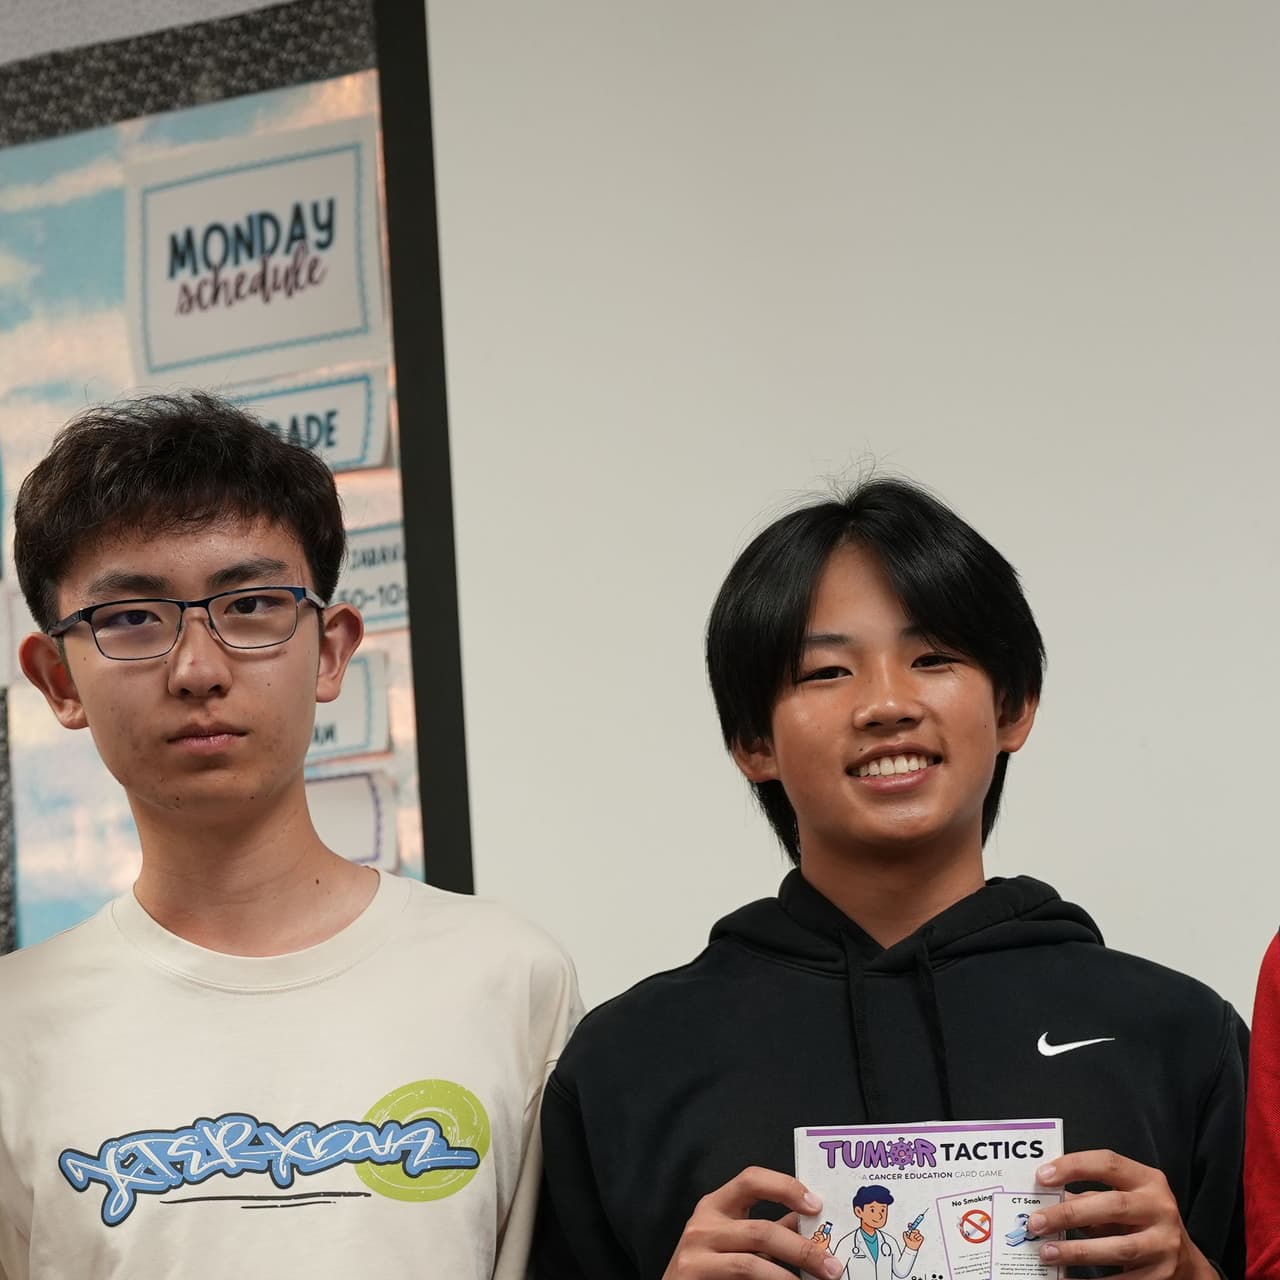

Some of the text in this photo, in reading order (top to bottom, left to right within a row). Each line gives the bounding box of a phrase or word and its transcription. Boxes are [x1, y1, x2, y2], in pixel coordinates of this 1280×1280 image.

[168, 199, 335, 280] MONDAY
[176, 242, 328, 317] schedule
[267, 408, 337, 449] ADE
[819, 1137, 1044, 1170] TUMOR TACTICS
[868, 1173, 903, 1181] CANCER
[904, 1171, 953, 1180] EDUCATION
[954, 1171, 977, 1179] CARD
[978, 1169, 1003, 1178] GAME
[963, 1194, 993, 1205] Smoking
